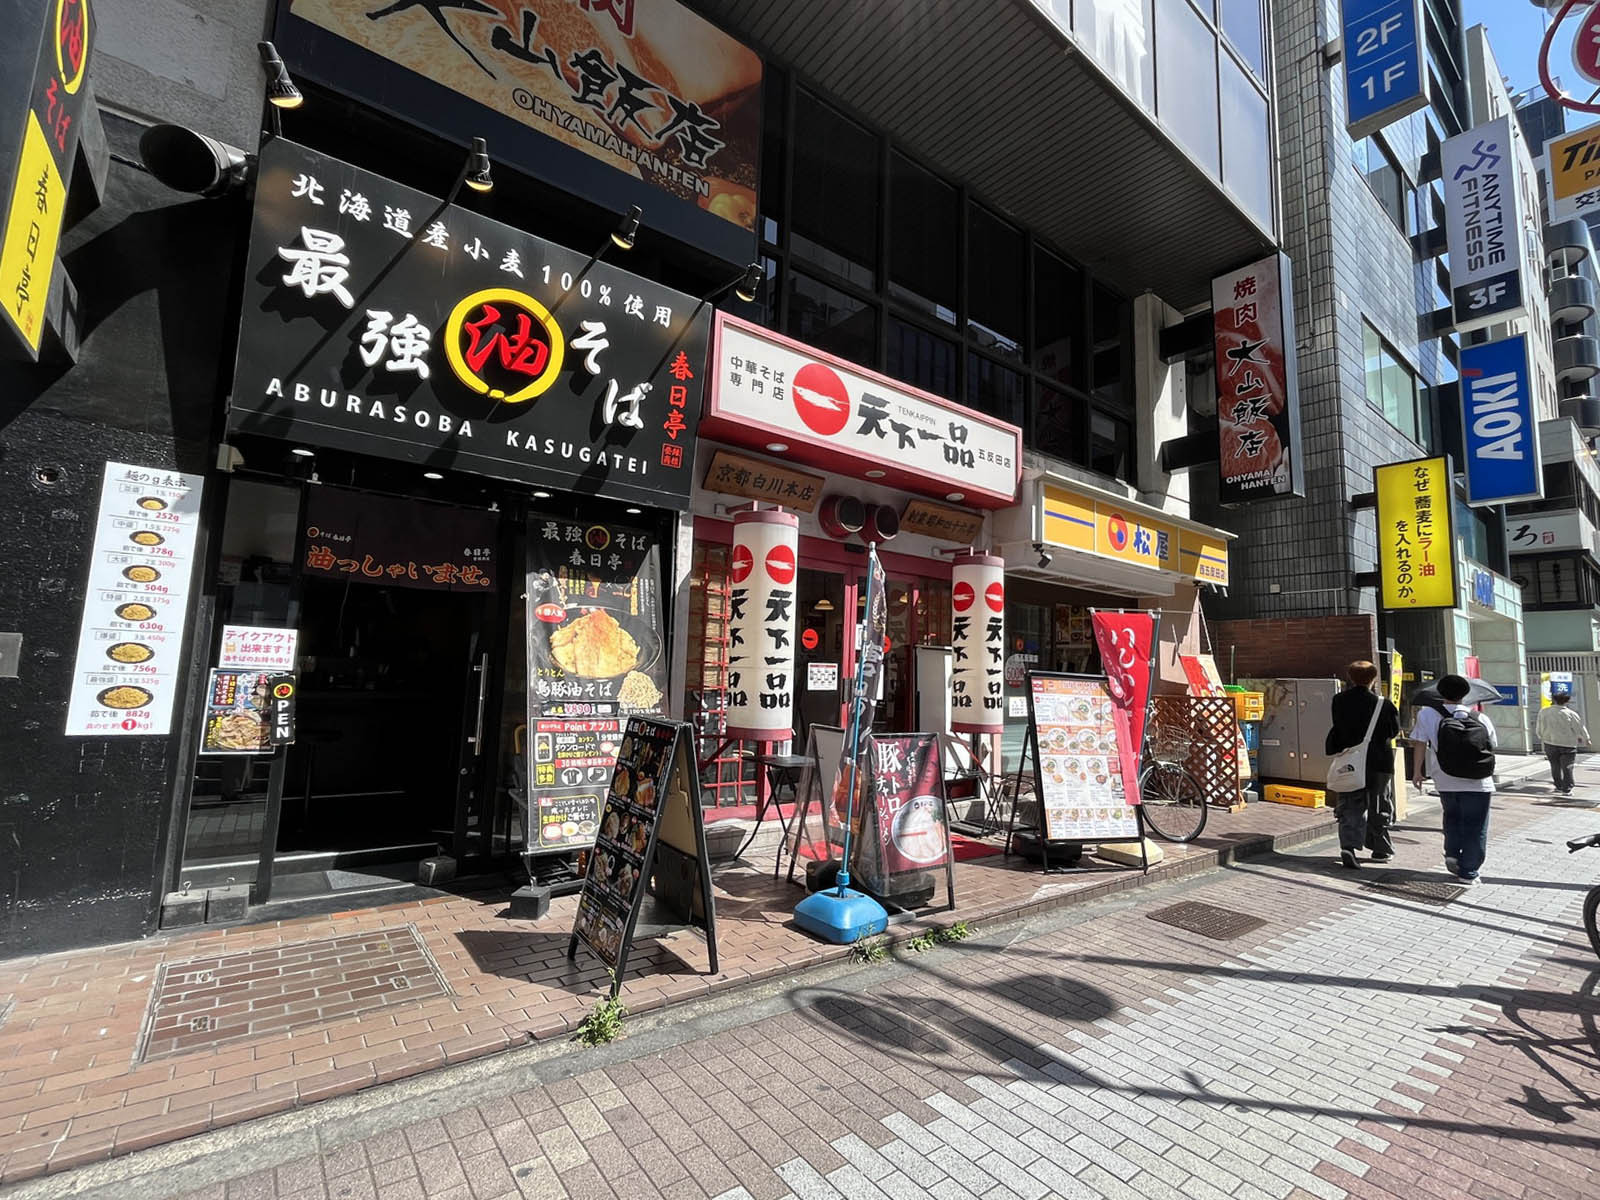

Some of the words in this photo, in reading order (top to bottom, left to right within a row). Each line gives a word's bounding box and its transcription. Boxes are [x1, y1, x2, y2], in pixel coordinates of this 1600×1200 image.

[1356, 12, 1403, 56] 2F
[1360, 61, 1406, 100] 1F
[511, 88, 711, 198] OHYAMAHANTEN
[1562, 134, 1600, 172] Ti
[1461, 178, 1485, 273] FITNESS
[1481, 174, 1506, 266] ANYTIME
[291, 174, 673, 328] 北海道産小麦100%使用
[1233, 275, 1258, 329] 焼肉
[1468, 281, 1506, 310] 3F
[730, 355, 785, 384] 中華そば
[730, 372, 785, 401] 専門店
[663, 350, 694, 440] 春日亭
[1226, 337, 1273, 458] 大山飯店
[265, 377, 473, 438] ABURASOBA
[506, 429, 650, 476] KASUGATEI
[856, 392, 976, 469] 天下一品
[897, 404, 937, 426] TENKAIPPIN
[1471, 371, 1524, 460] AOKI
[977, 448, 1012, 469] 五反田店
[1226, 469, 1273, 484] OHYAMA
[715, 463, 814, 502] 京都白川本店
[1241, 474, 1287, 490] HANTEN
[155, 511, 180, 522] 252g
[569, 549, 623, 571] 春日亭
[1133, 522, 1169, 562] 松屋
[306, 544, 491, 586] 油っしゃいませ。
[144, 584, 169, 593] 504g
[225, 630, 295, 642] テイクアウト
[758, 589, 793, 710] 天下一品
[132, 664, 157, 674] 756g
[125, 711, 151, 719] 882g
[564, 722, 586, 732] Point
[589, 721, 613, 731] アプリ
